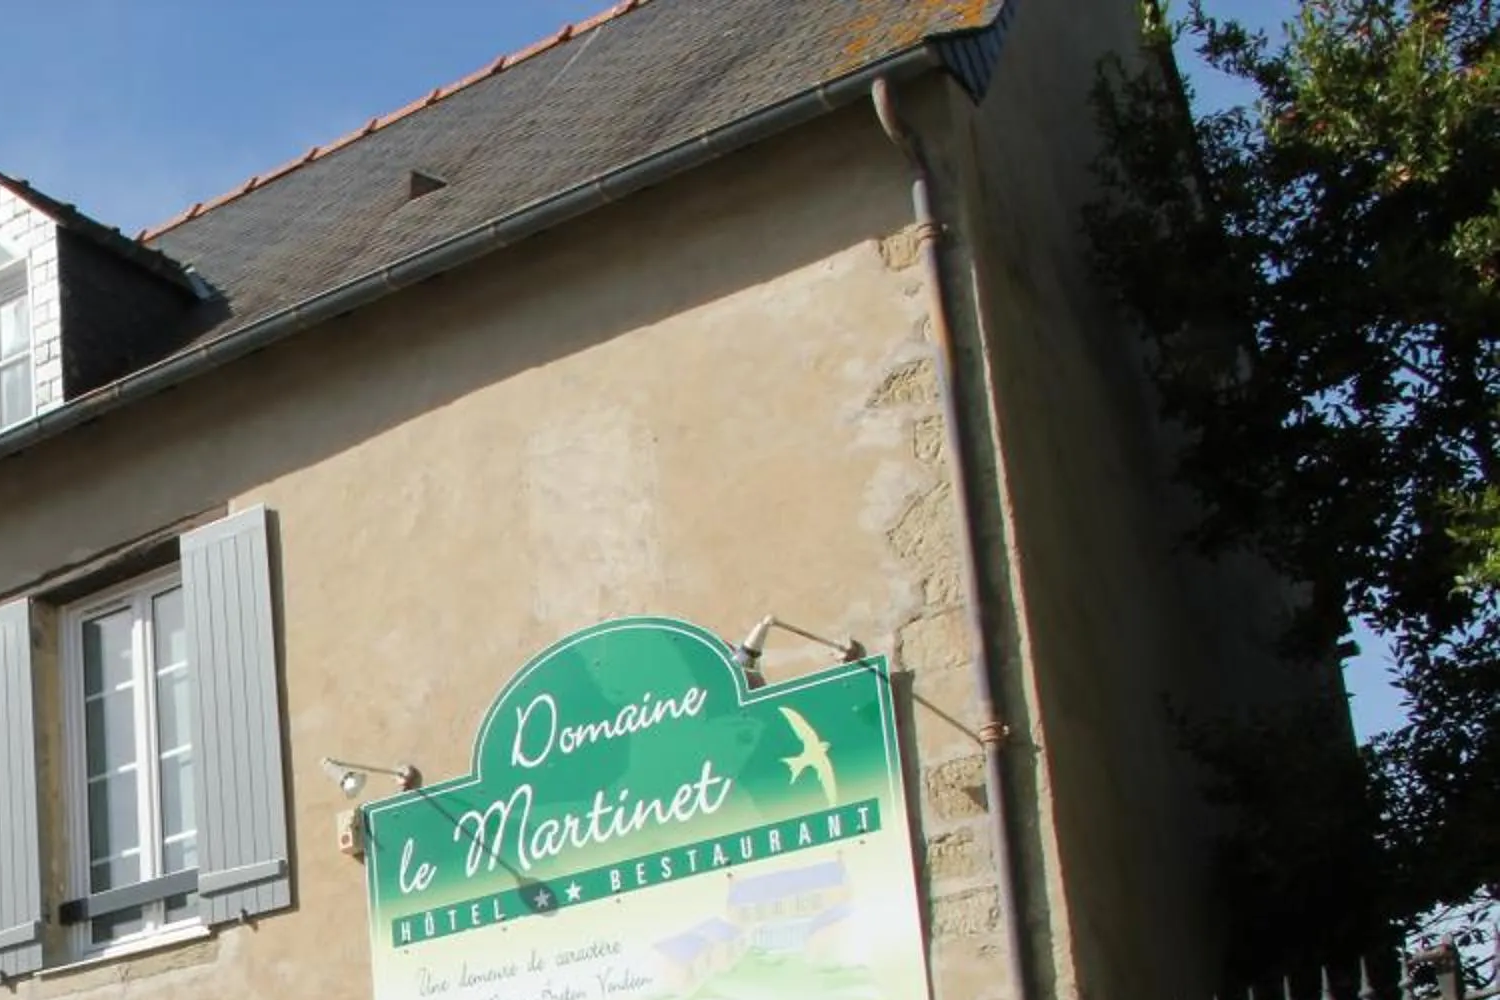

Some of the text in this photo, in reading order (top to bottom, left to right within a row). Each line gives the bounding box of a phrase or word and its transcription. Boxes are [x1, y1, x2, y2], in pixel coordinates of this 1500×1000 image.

[511, 686, 708, 768] Domaine
[400, 760, 733, 894] le Martinet
[401, 898, 506, 942] HÔTEL
